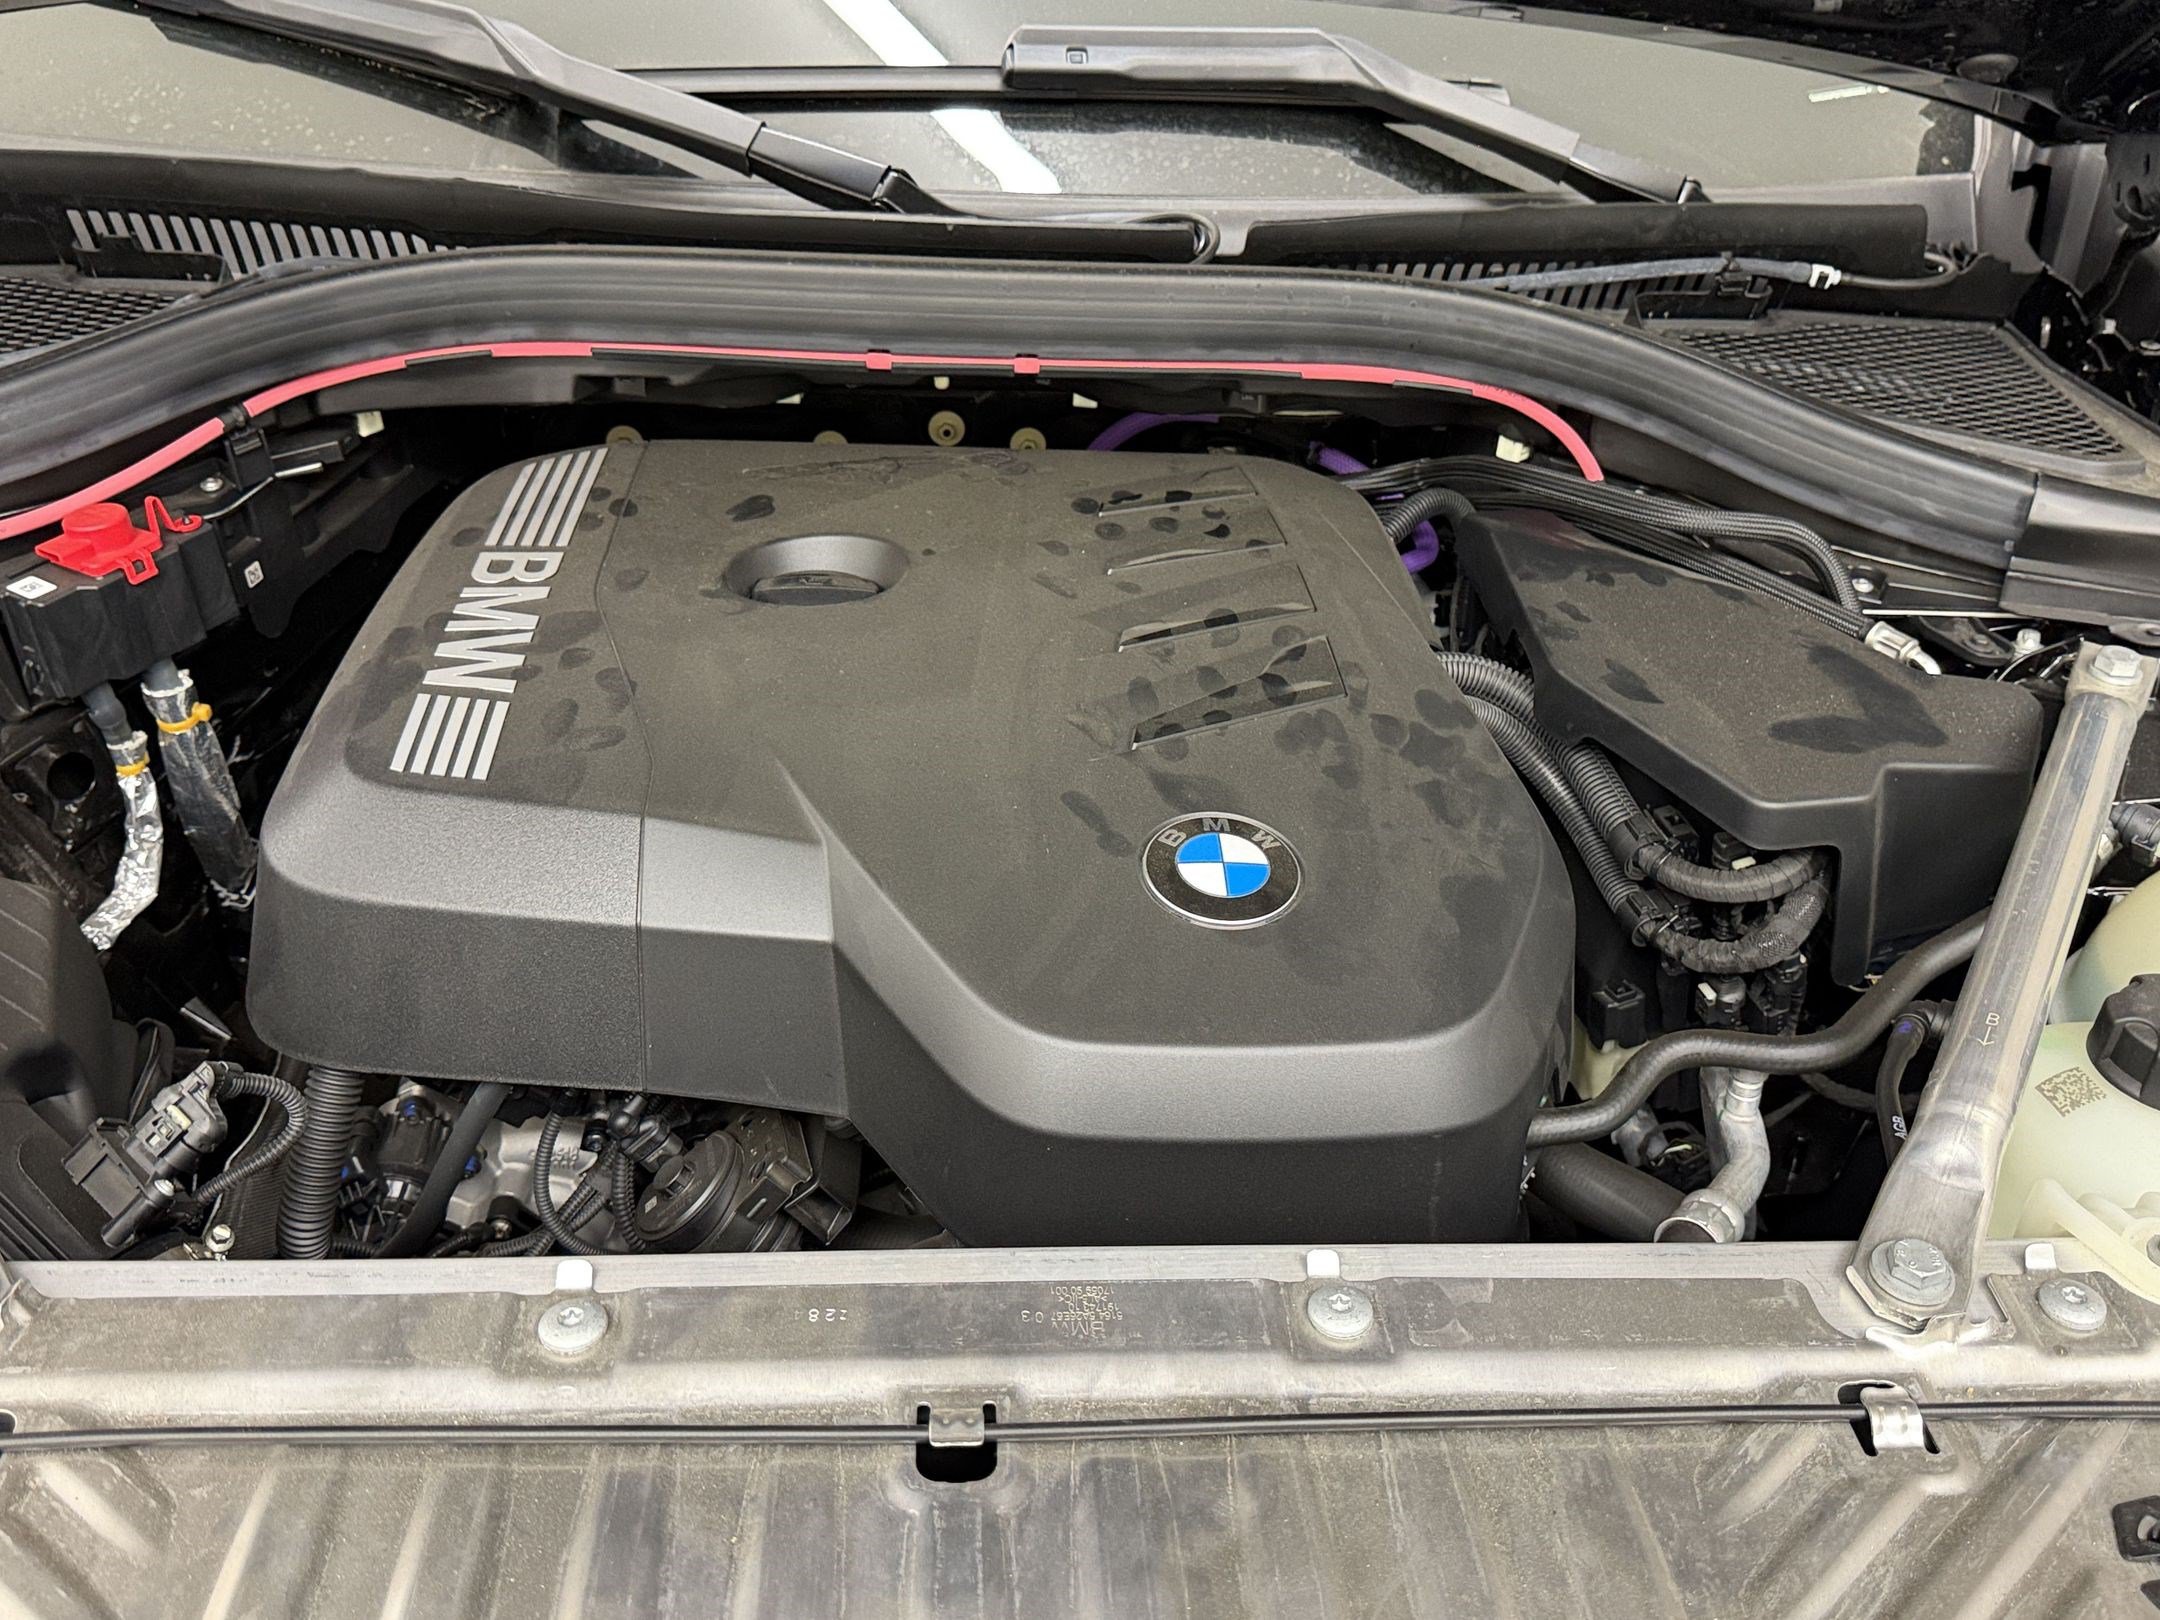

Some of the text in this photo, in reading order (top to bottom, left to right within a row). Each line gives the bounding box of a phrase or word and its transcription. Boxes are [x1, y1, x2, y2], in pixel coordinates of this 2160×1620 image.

[422, 552, 564, 693] BMW
[1157, 817, 1281, 851] BMW
[1985, 1012, 1999, 1026] B
